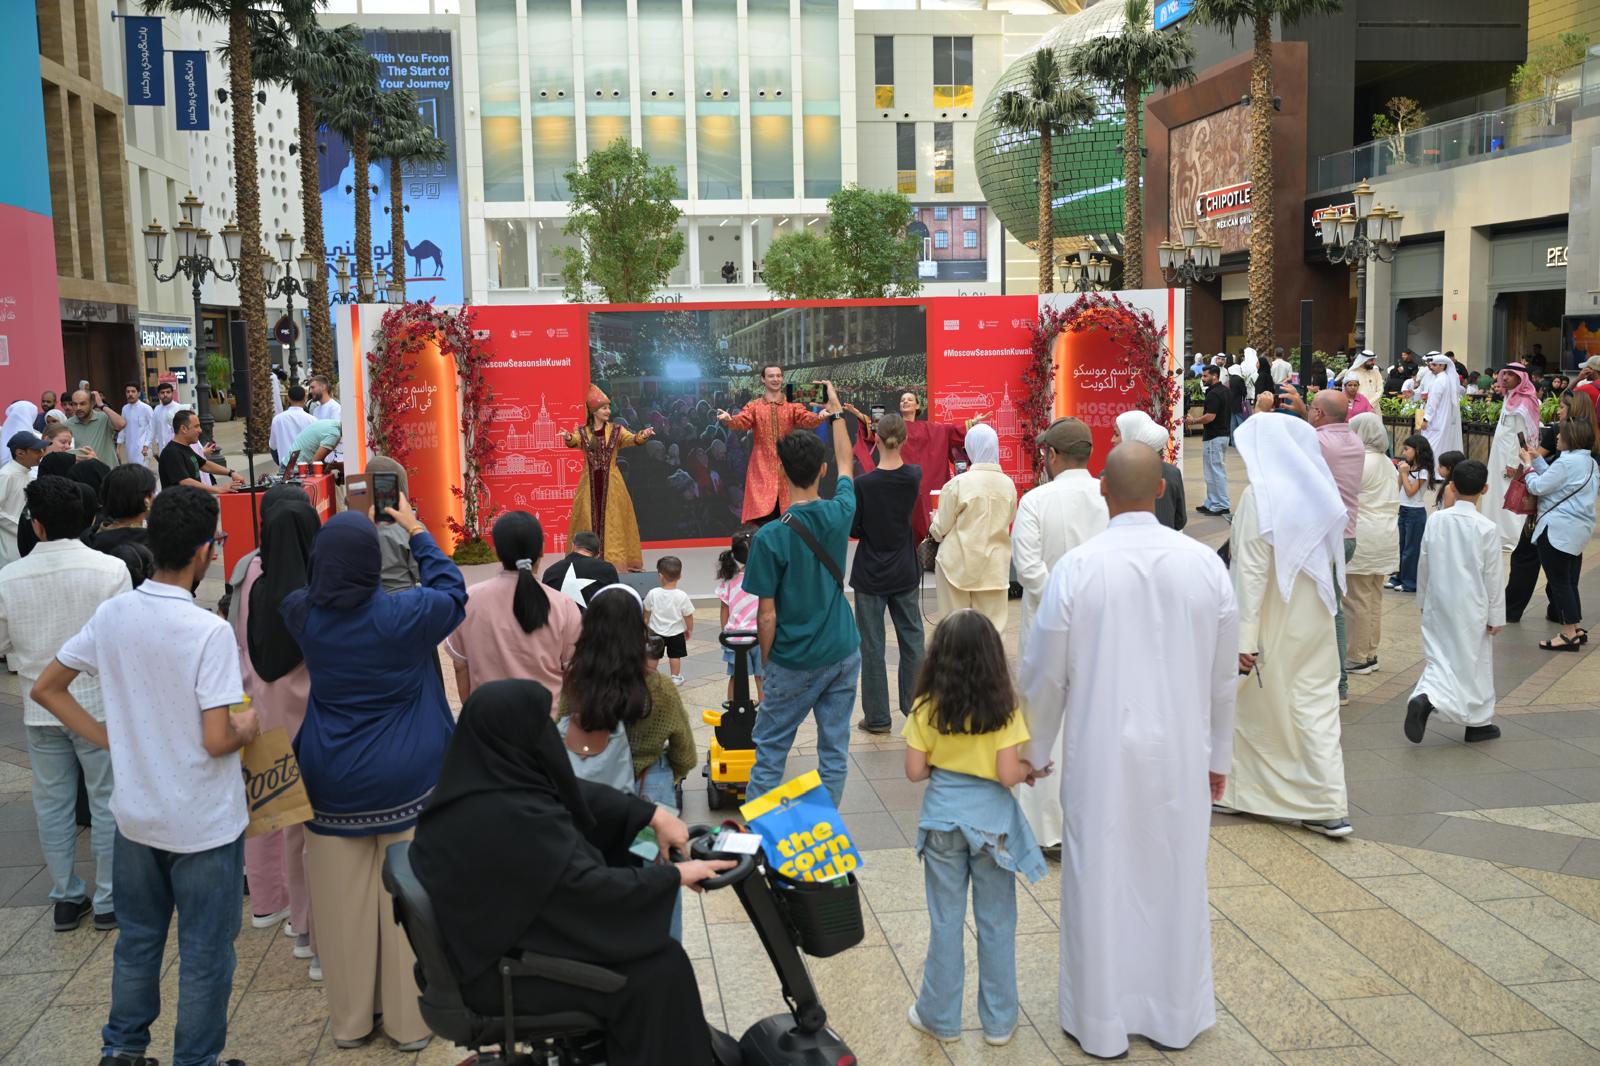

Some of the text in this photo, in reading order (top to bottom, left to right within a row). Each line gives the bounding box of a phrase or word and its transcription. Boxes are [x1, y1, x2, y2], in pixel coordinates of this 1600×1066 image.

[371, 53, 449, 63] With You From
[387, 66, 450, 76] The Start of
[379, 79, 450, 90] Your Journey
[1206, 188, 1251, 211] CHIPOTLE
[1216, 214, 1252, 229] MEXICAN GRIL
[325, 262, 394, 278] NK
[142, 330, 155, 346] Bath
[160, 331, 173, 350] Body
[172, 332, 189, 347] Works
[481, 358, 571, 369] oscowSeasonsInKuwait
[1073, 364, 1107, 378] موسكو
[411, 380, 438, 397] مواسم
[1080, 375, 1135, 394] في الكويت
[419, 398, 432, 414] في
[776, 821, 833, 858] the
[778, 834, 850, 879] corn
[803, 853, 857, 883] ub
